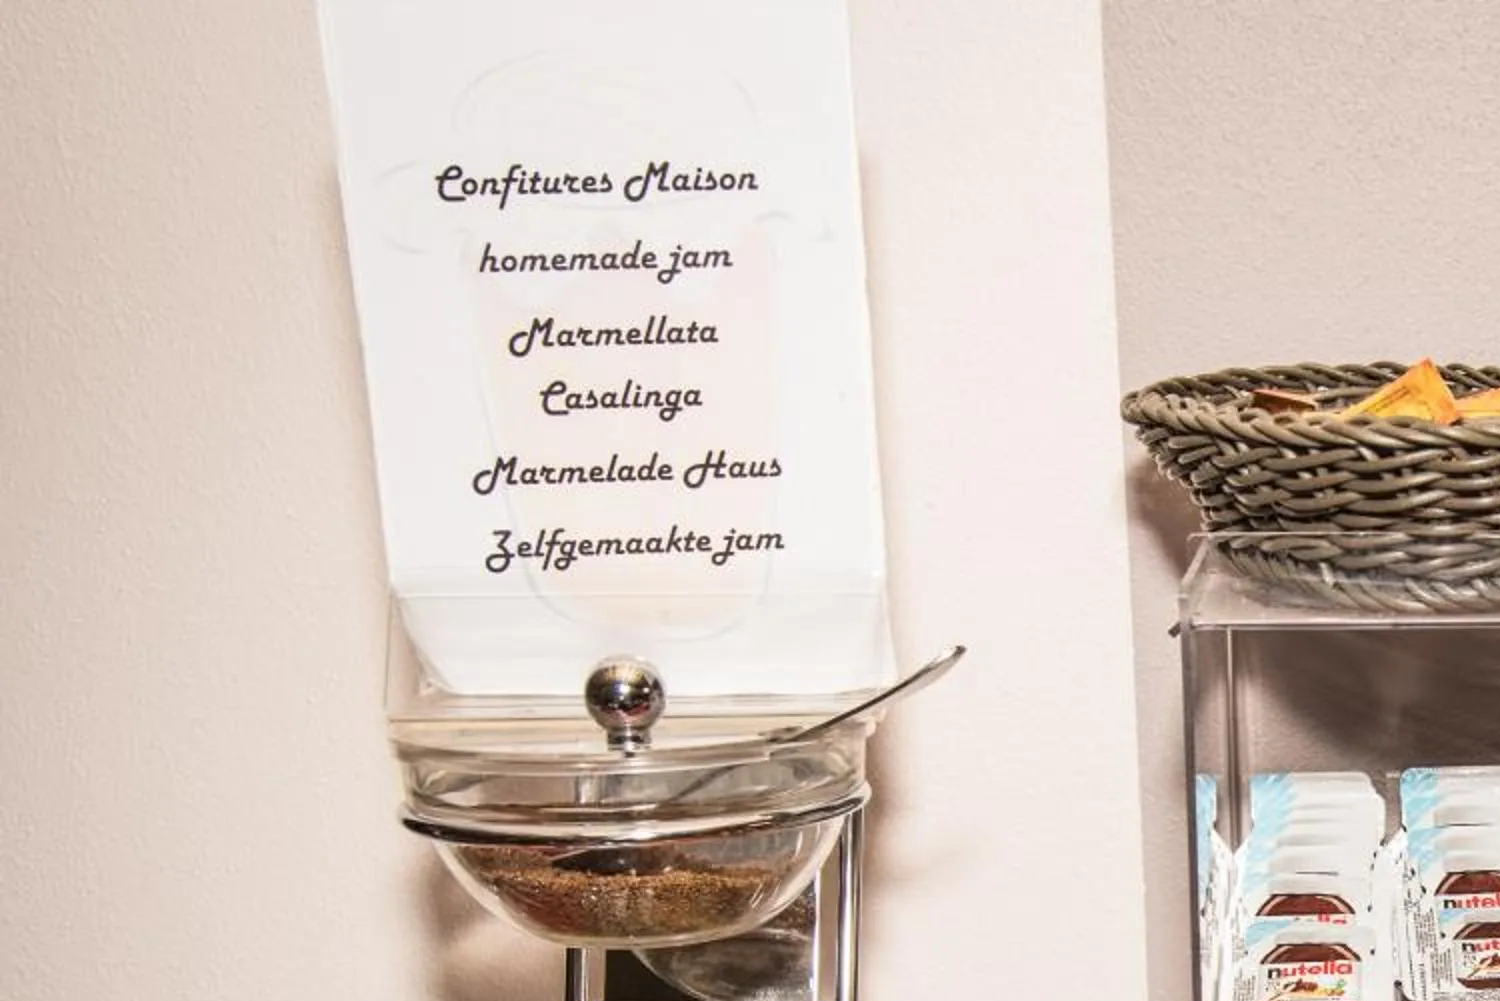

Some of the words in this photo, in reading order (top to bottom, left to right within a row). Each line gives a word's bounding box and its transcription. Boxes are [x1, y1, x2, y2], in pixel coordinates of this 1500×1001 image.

[435, 164, 613, 210] Confitures
[623, 161, 758, 202] Maison
[479, 240, 658, 273] homemade
[656, 245, 733, 284] jam
[508, 315, 719, 357] Marmellata
[540, 379, 703, 421] Casalinga
[472, 452, 675, 495] Marmelade
[683, 450, 783, 488] Haus
[485, 524, 712, 573] Zelfgemaakte
[711, 529, 785, 566] jam
[1267, 960, 1353, 979] nutella
